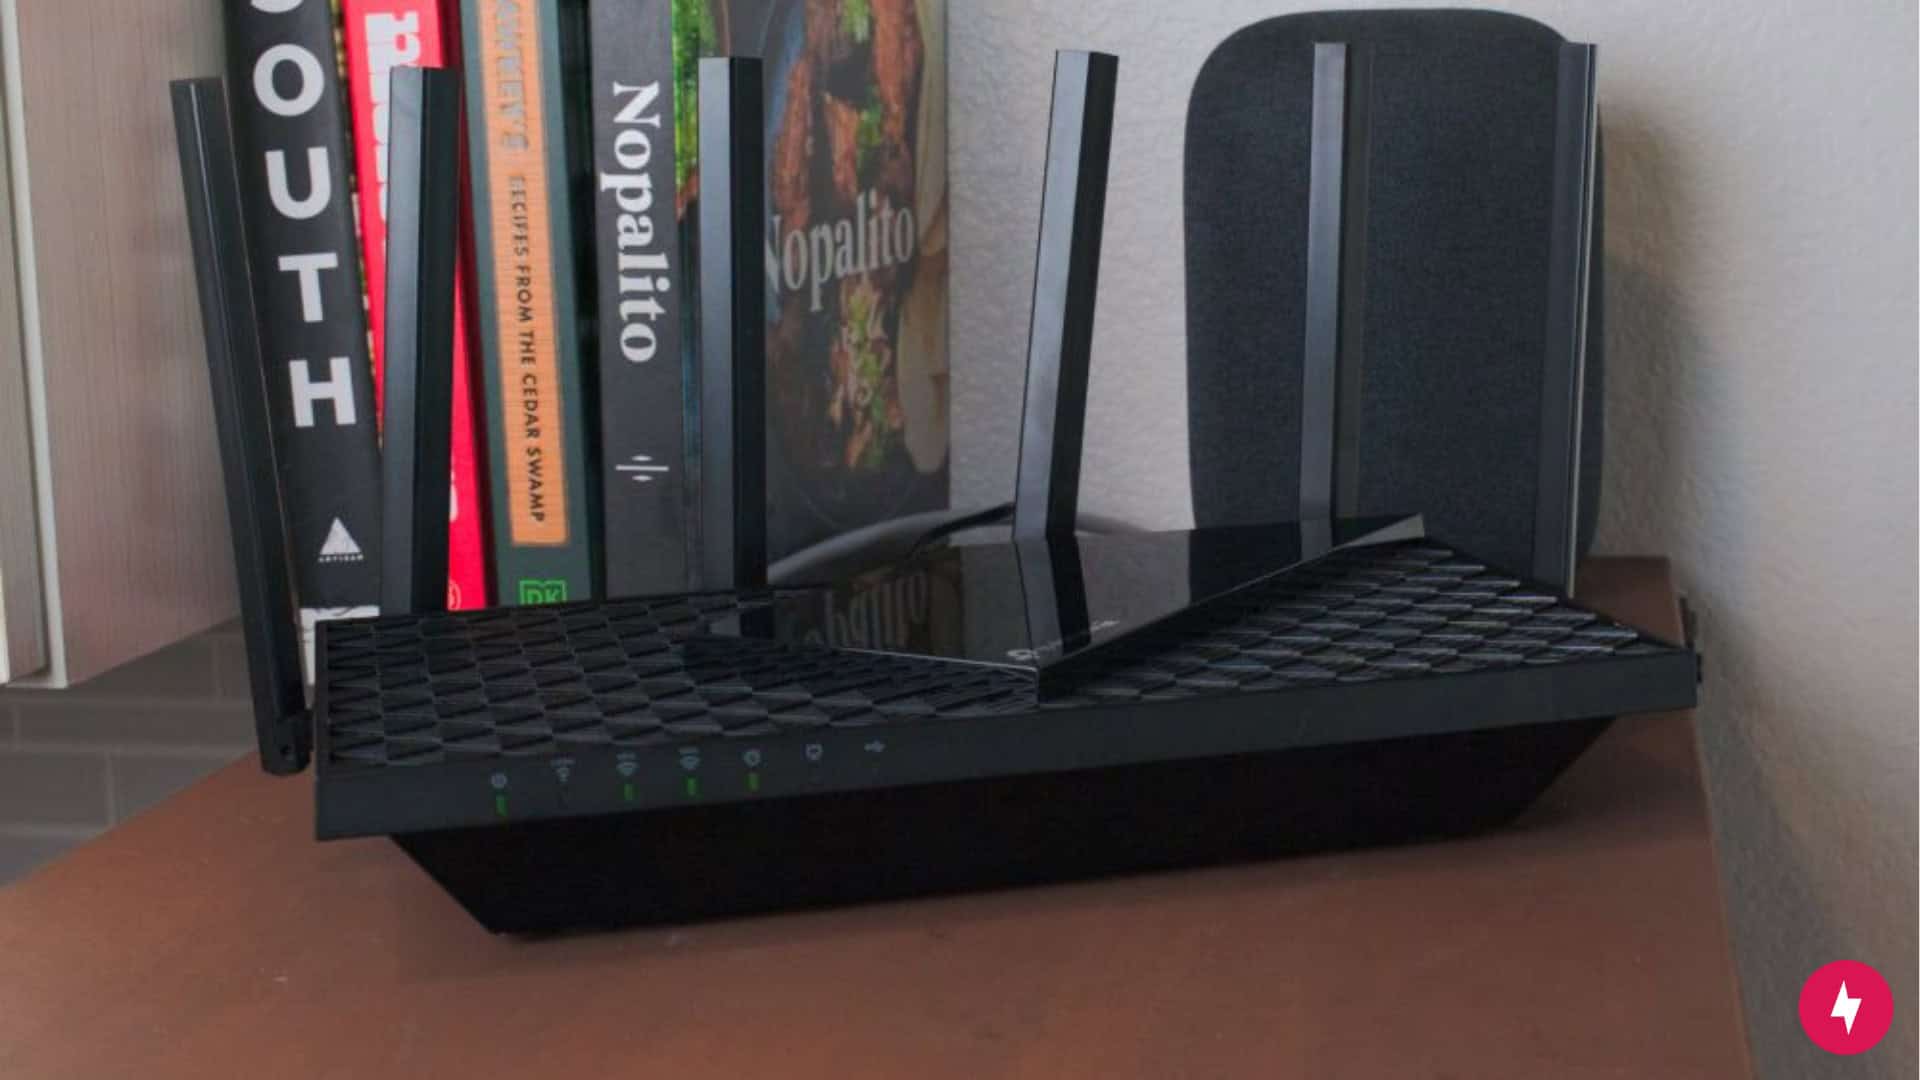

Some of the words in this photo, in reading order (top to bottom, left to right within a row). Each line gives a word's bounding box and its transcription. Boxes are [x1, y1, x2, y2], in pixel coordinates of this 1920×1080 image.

[251, 0, 356, 427] OUTH
[600, 81, 671, 363] Nopalito
[515, 265, 534, 323] FROM
[520, 331, 536, 365] THE
[522, 373, 540, 439] CEDAR
[527, 447, 546, 522] SWAMP
